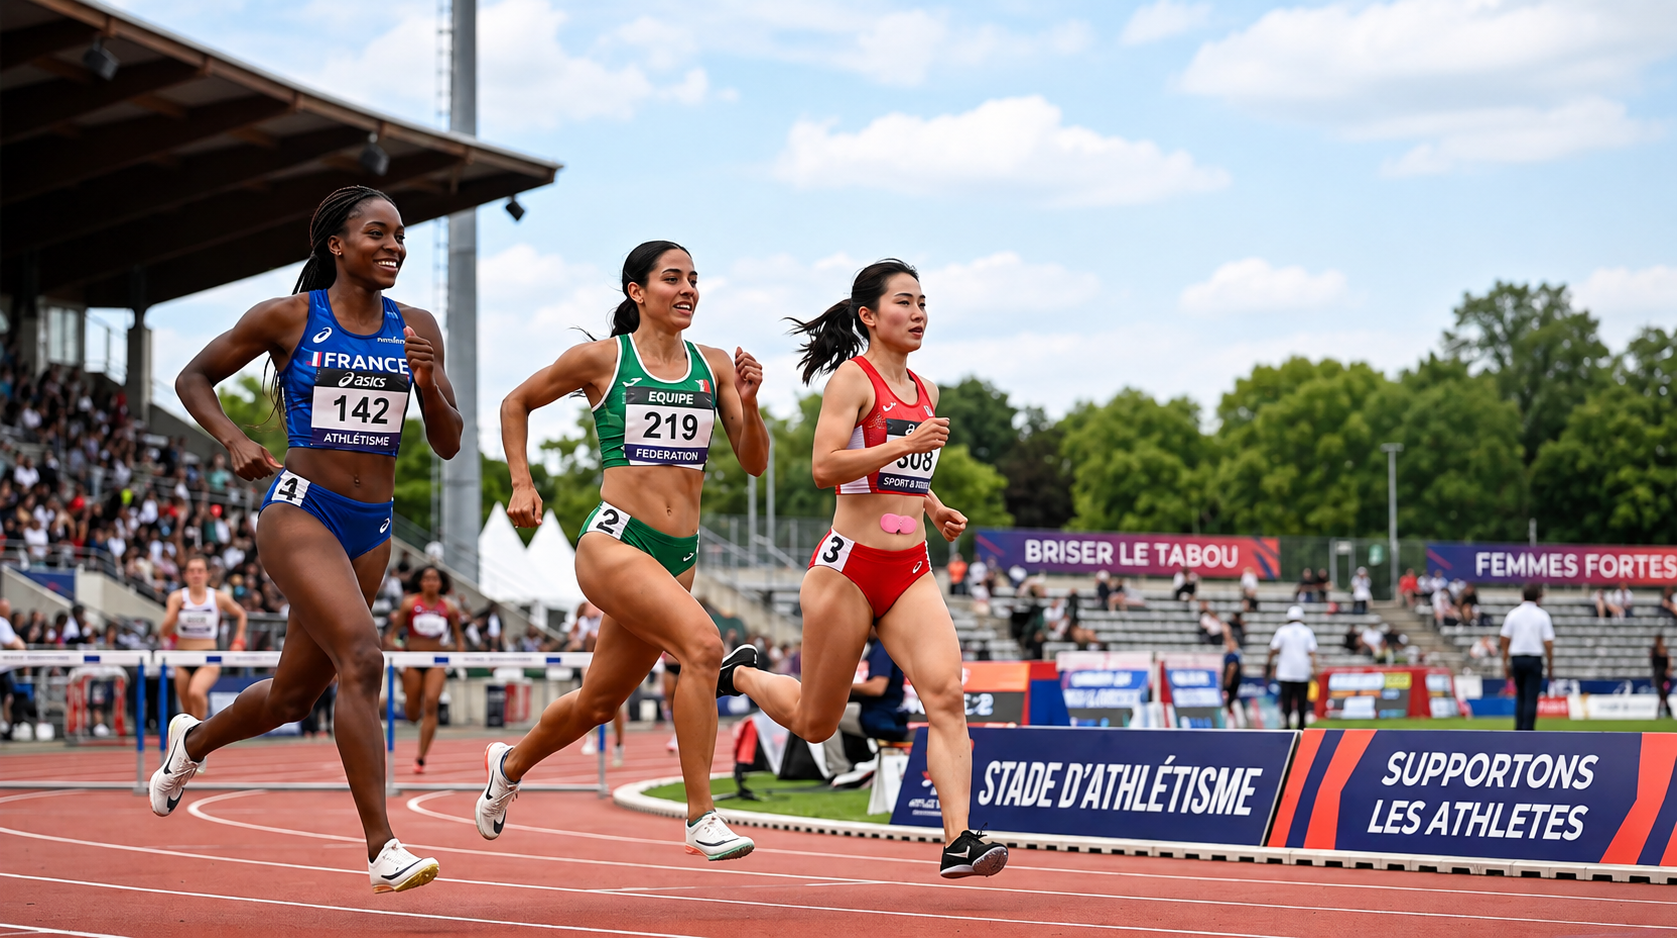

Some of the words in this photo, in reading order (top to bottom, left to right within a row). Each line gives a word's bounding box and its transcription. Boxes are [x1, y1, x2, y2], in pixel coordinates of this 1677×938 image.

[324, 352, 410, 375] FRANCE
[354, 374, 387, 388] asics
[333, 394, 390, 425] 142
[648, 391, 694, 405] EQUIPE
[323, 432, 390, 447] ATHLÉTISME
[643, 411, 698, 441] 219
[636, 448, 699, 461] FEDERATION
[278, 477, 299, 501] 4
[883, 476, 910, 488] SPORT
[596, 508, 620, 535] 2
[822, 535, 845, 563] 3
[1024, 538, 1114, 566] BRISER
[1119, 541, 1150, 567] LE
[1154, 543, 1239, 569] TABOU
[1475, 551, 1578, 578] FEMMES
[1585, 553, 1677, 579] FORTES
[1381, 750, 1600, 790] SUPPORTONS
[978, 760, 1063, 808] STADE
[1057, 755, 1264, 816] D'ATHLÉTISME
[1366, 799, 1427, 836] LES
[1424, 801, 1590, 841] ATHLETES
